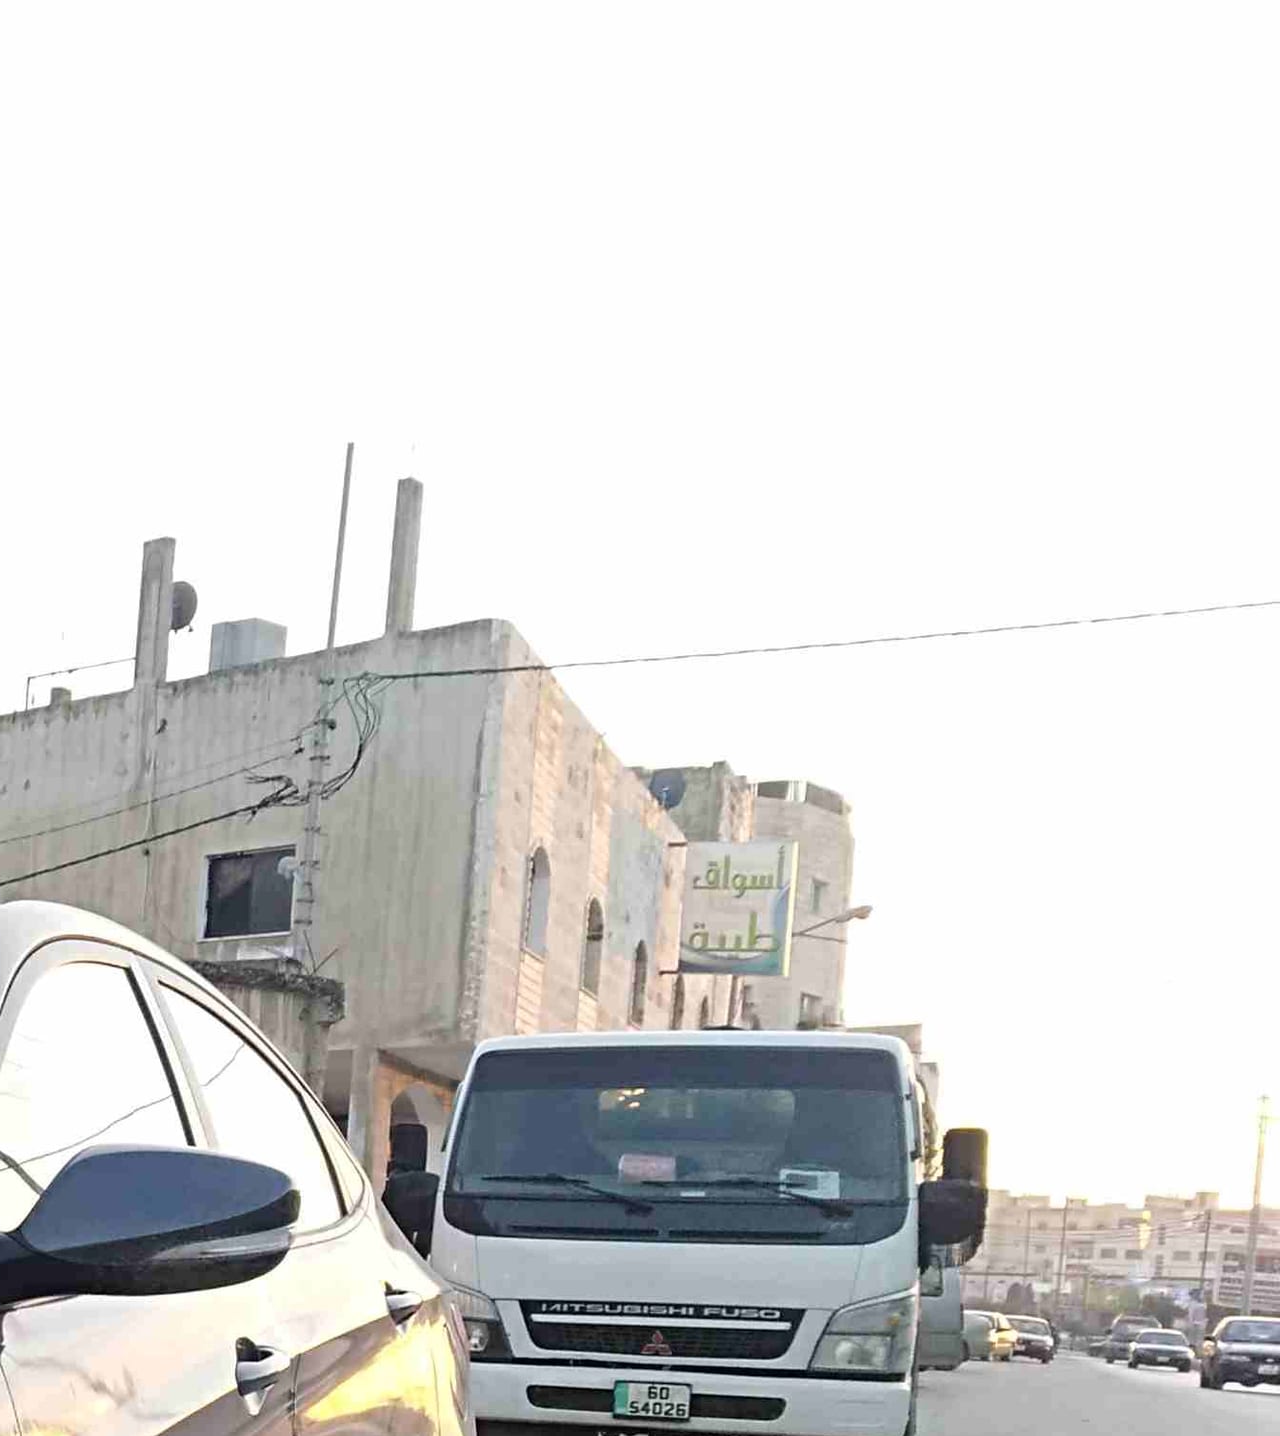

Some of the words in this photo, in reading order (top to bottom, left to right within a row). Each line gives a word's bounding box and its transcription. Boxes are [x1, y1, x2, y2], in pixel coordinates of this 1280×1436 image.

[692, 845, 785, 898] أسواق
[541, 1302, 694, 1316] MITSUBISHI
[703, 1306, 781, 1319] FUSO
[647, 1386, 670, 1400] 60
[629, 1401, 687, 1416] 54026
